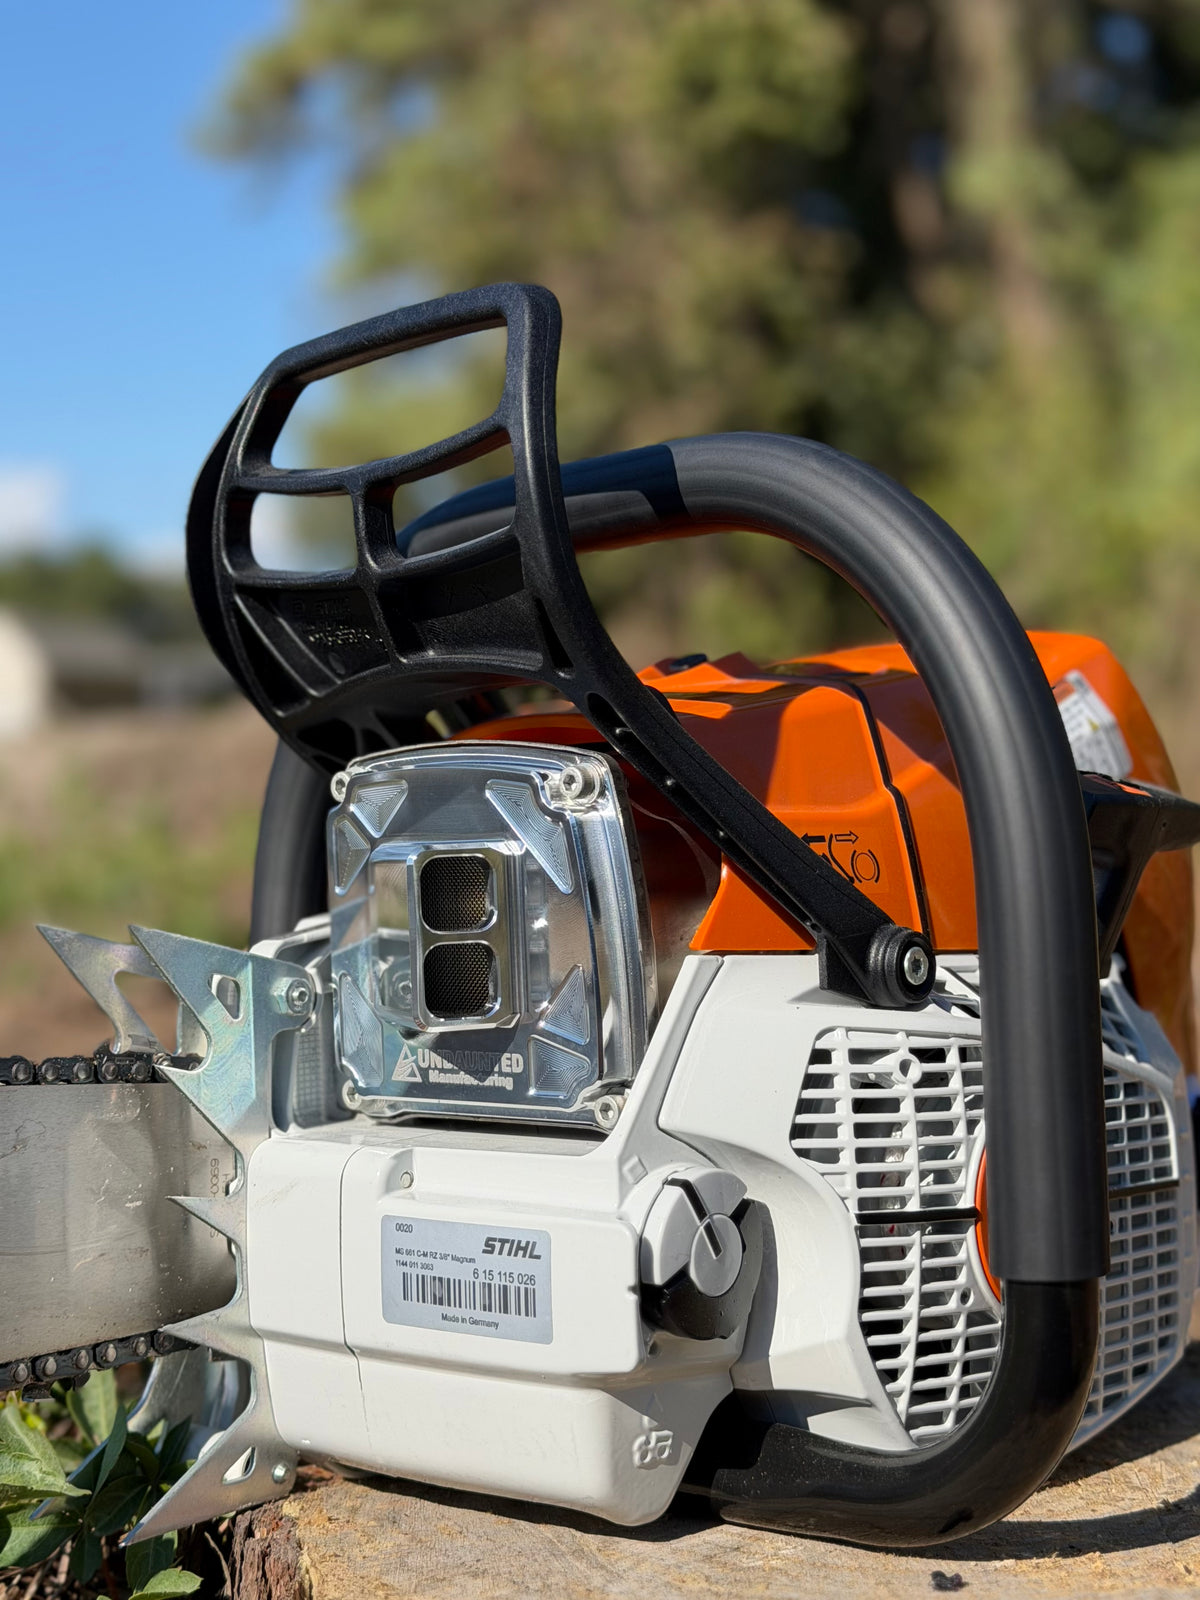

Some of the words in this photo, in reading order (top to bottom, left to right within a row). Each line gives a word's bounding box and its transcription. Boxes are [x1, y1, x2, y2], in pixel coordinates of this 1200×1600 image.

[417, 1048, 524, 1073] UNDAUNTED
[395, 1222, 414, 1234] 0020
[395, 1247, 405, 1256] MS
[416, 1249, 429, 1259] C-M
[429, 1251, 438, 1260] RZ
[451, 1254, 476, 1264] Magnum
[481, 1236, 542, 1260] STIHL
[395, 1259, 408, 1268] 1144
[408, 1261, 419, 1269] 011
[472, 1267, 480, 1280] 6
[482, 1269, 495, 1282] 15
[497, 1270, 515, 1284] 115
[517, 1273, 537, 1287] 026
[441, 1312, 460, 1324] Made
[460, 1315, 468, 1325] in
[468, 1316, 500, 1331] Germany
